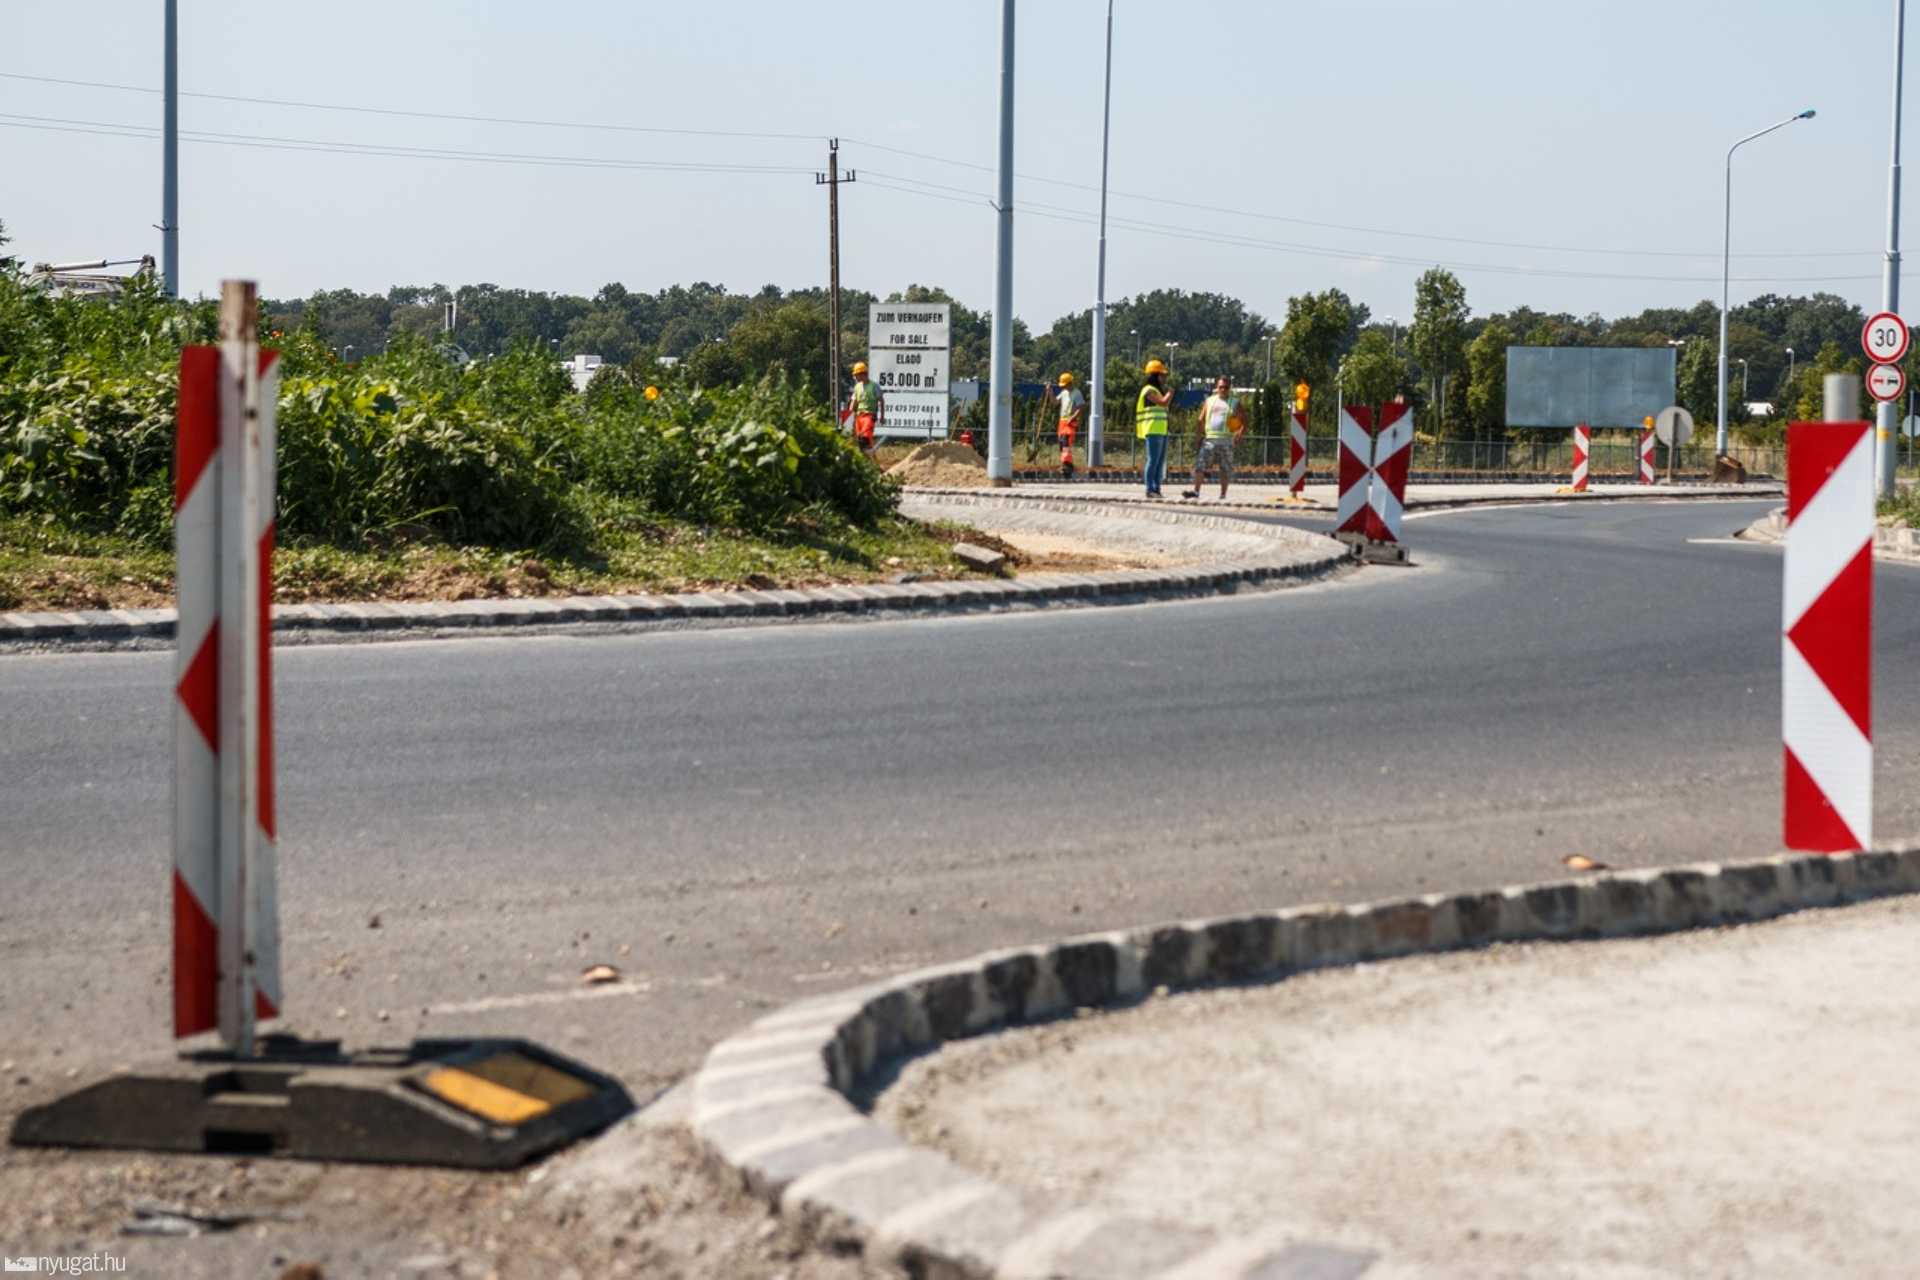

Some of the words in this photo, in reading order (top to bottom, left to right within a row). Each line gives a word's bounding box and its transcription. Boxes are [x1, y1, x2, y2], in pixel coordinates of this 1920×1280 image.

[876, 312, 895, 323] ZUM
[897, 312, 944, 323] VERKAUFEN
[889, 334, 905, 344] FOR
[908, 334, 928, 344] SALE
[1875, 328, 1896, 347] 30
[879, 372, 920, 387] 53.000
